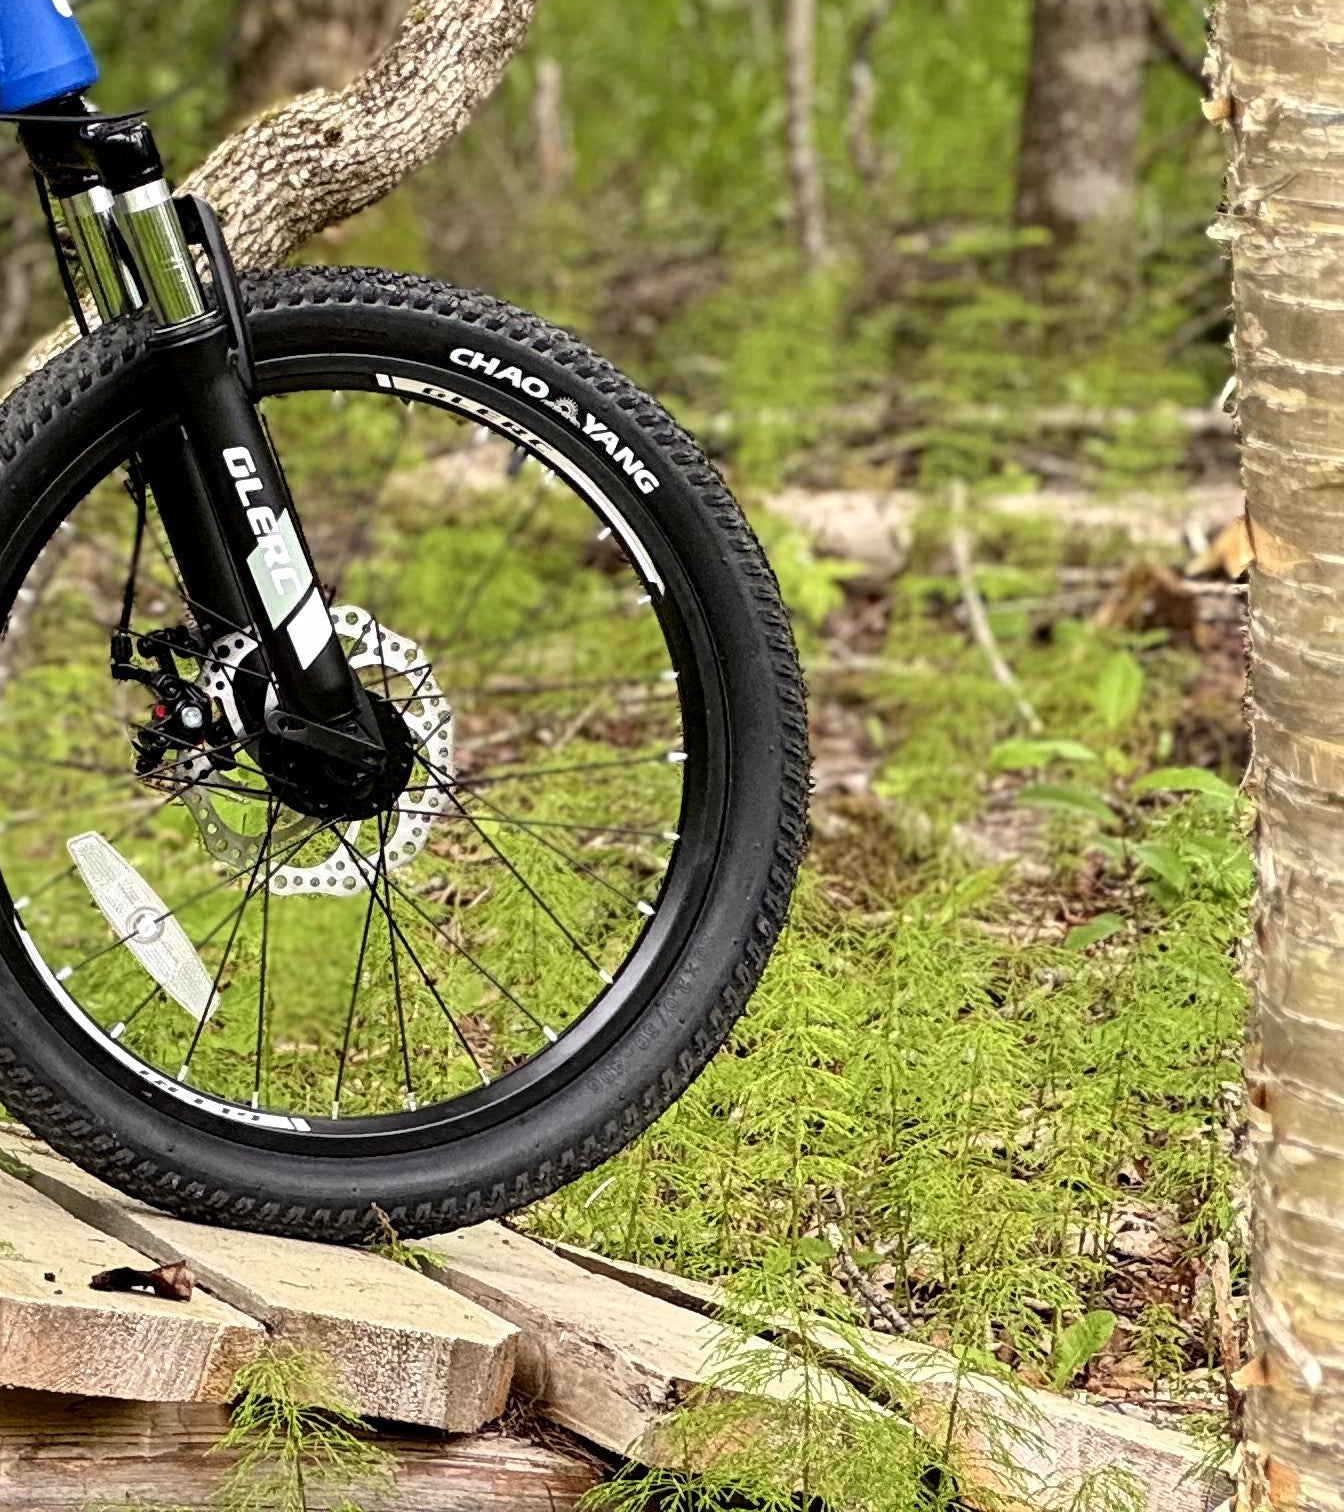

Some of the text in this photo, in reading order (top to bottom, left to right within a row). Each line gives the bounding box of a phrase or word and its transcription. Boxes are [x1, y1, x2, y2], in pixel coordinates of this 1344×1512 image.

[448, 348, 661, 494] CHAO YANG
[222, 446, 302, 597] GLERC
